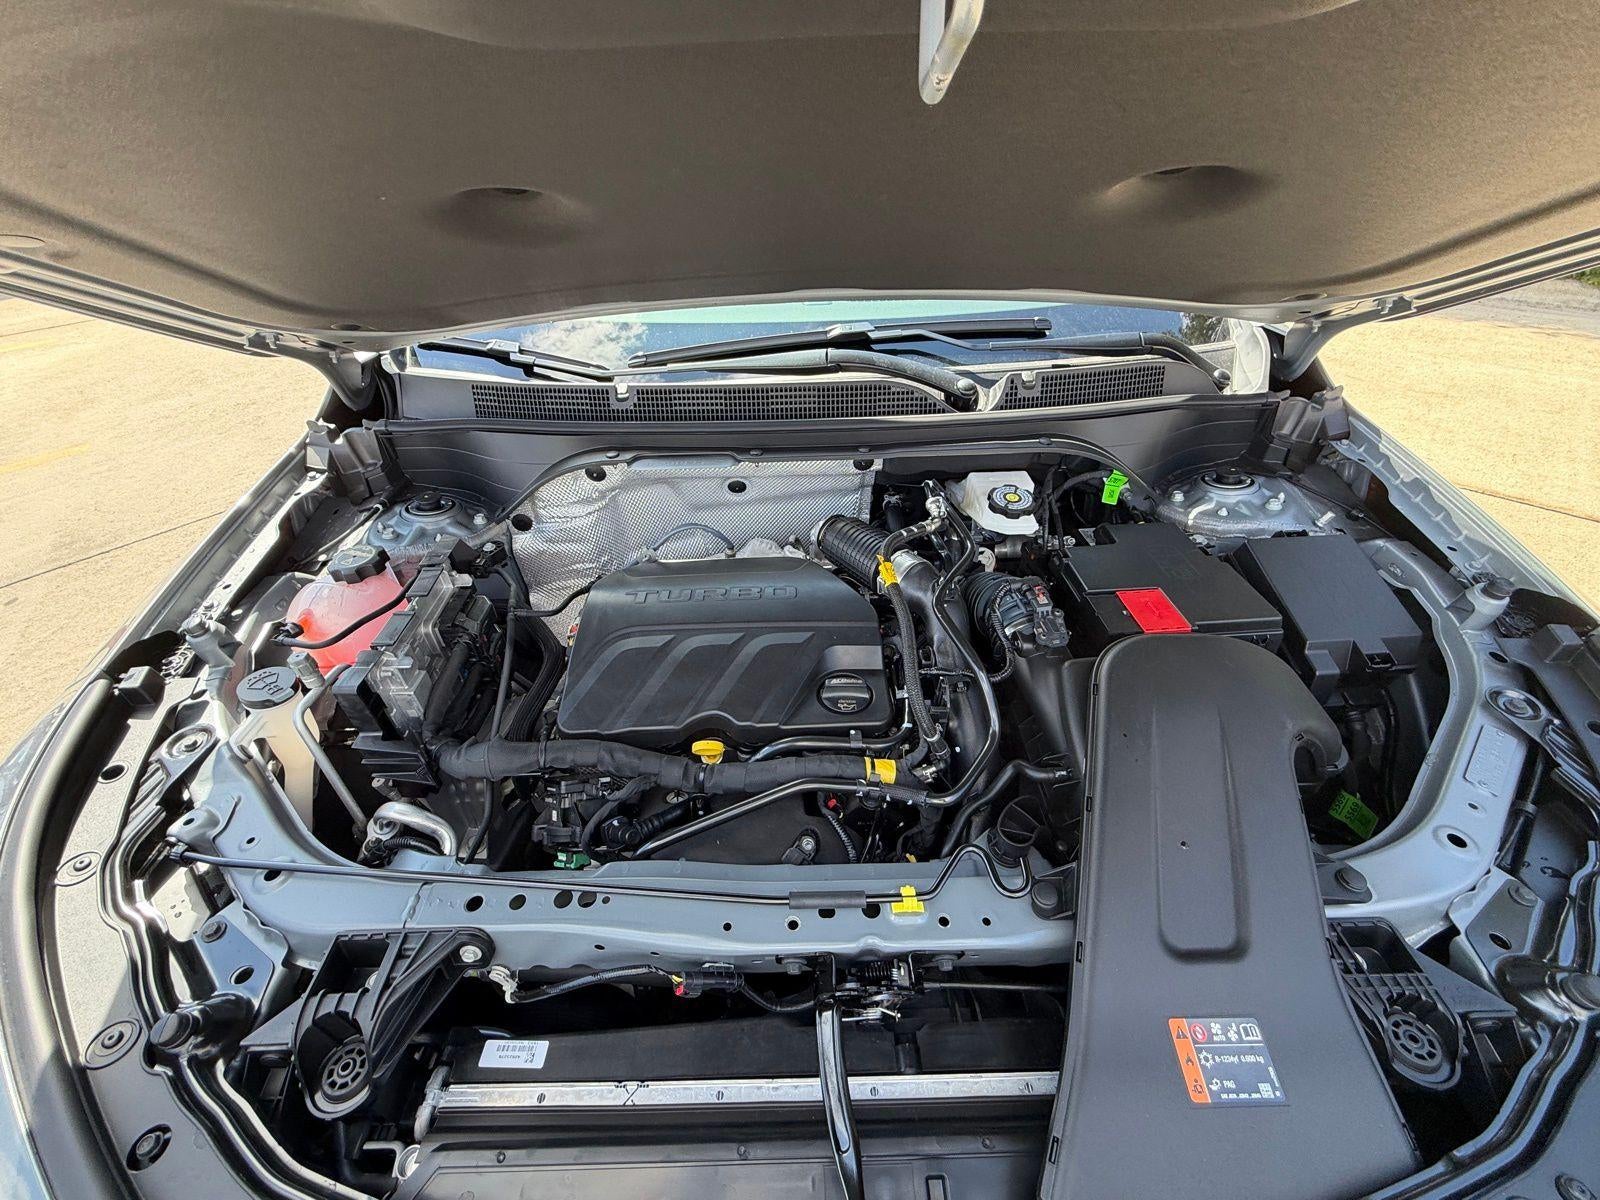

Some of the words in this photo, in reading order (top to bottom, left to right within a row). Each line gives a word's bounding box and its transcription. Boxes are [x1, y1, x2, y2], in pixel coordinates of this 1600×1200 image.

[625, 585, 798, 604] TURBO
[1256, 1054, 1264, 1064] kg
[1223, 1080, 1236, 1089] PAG
